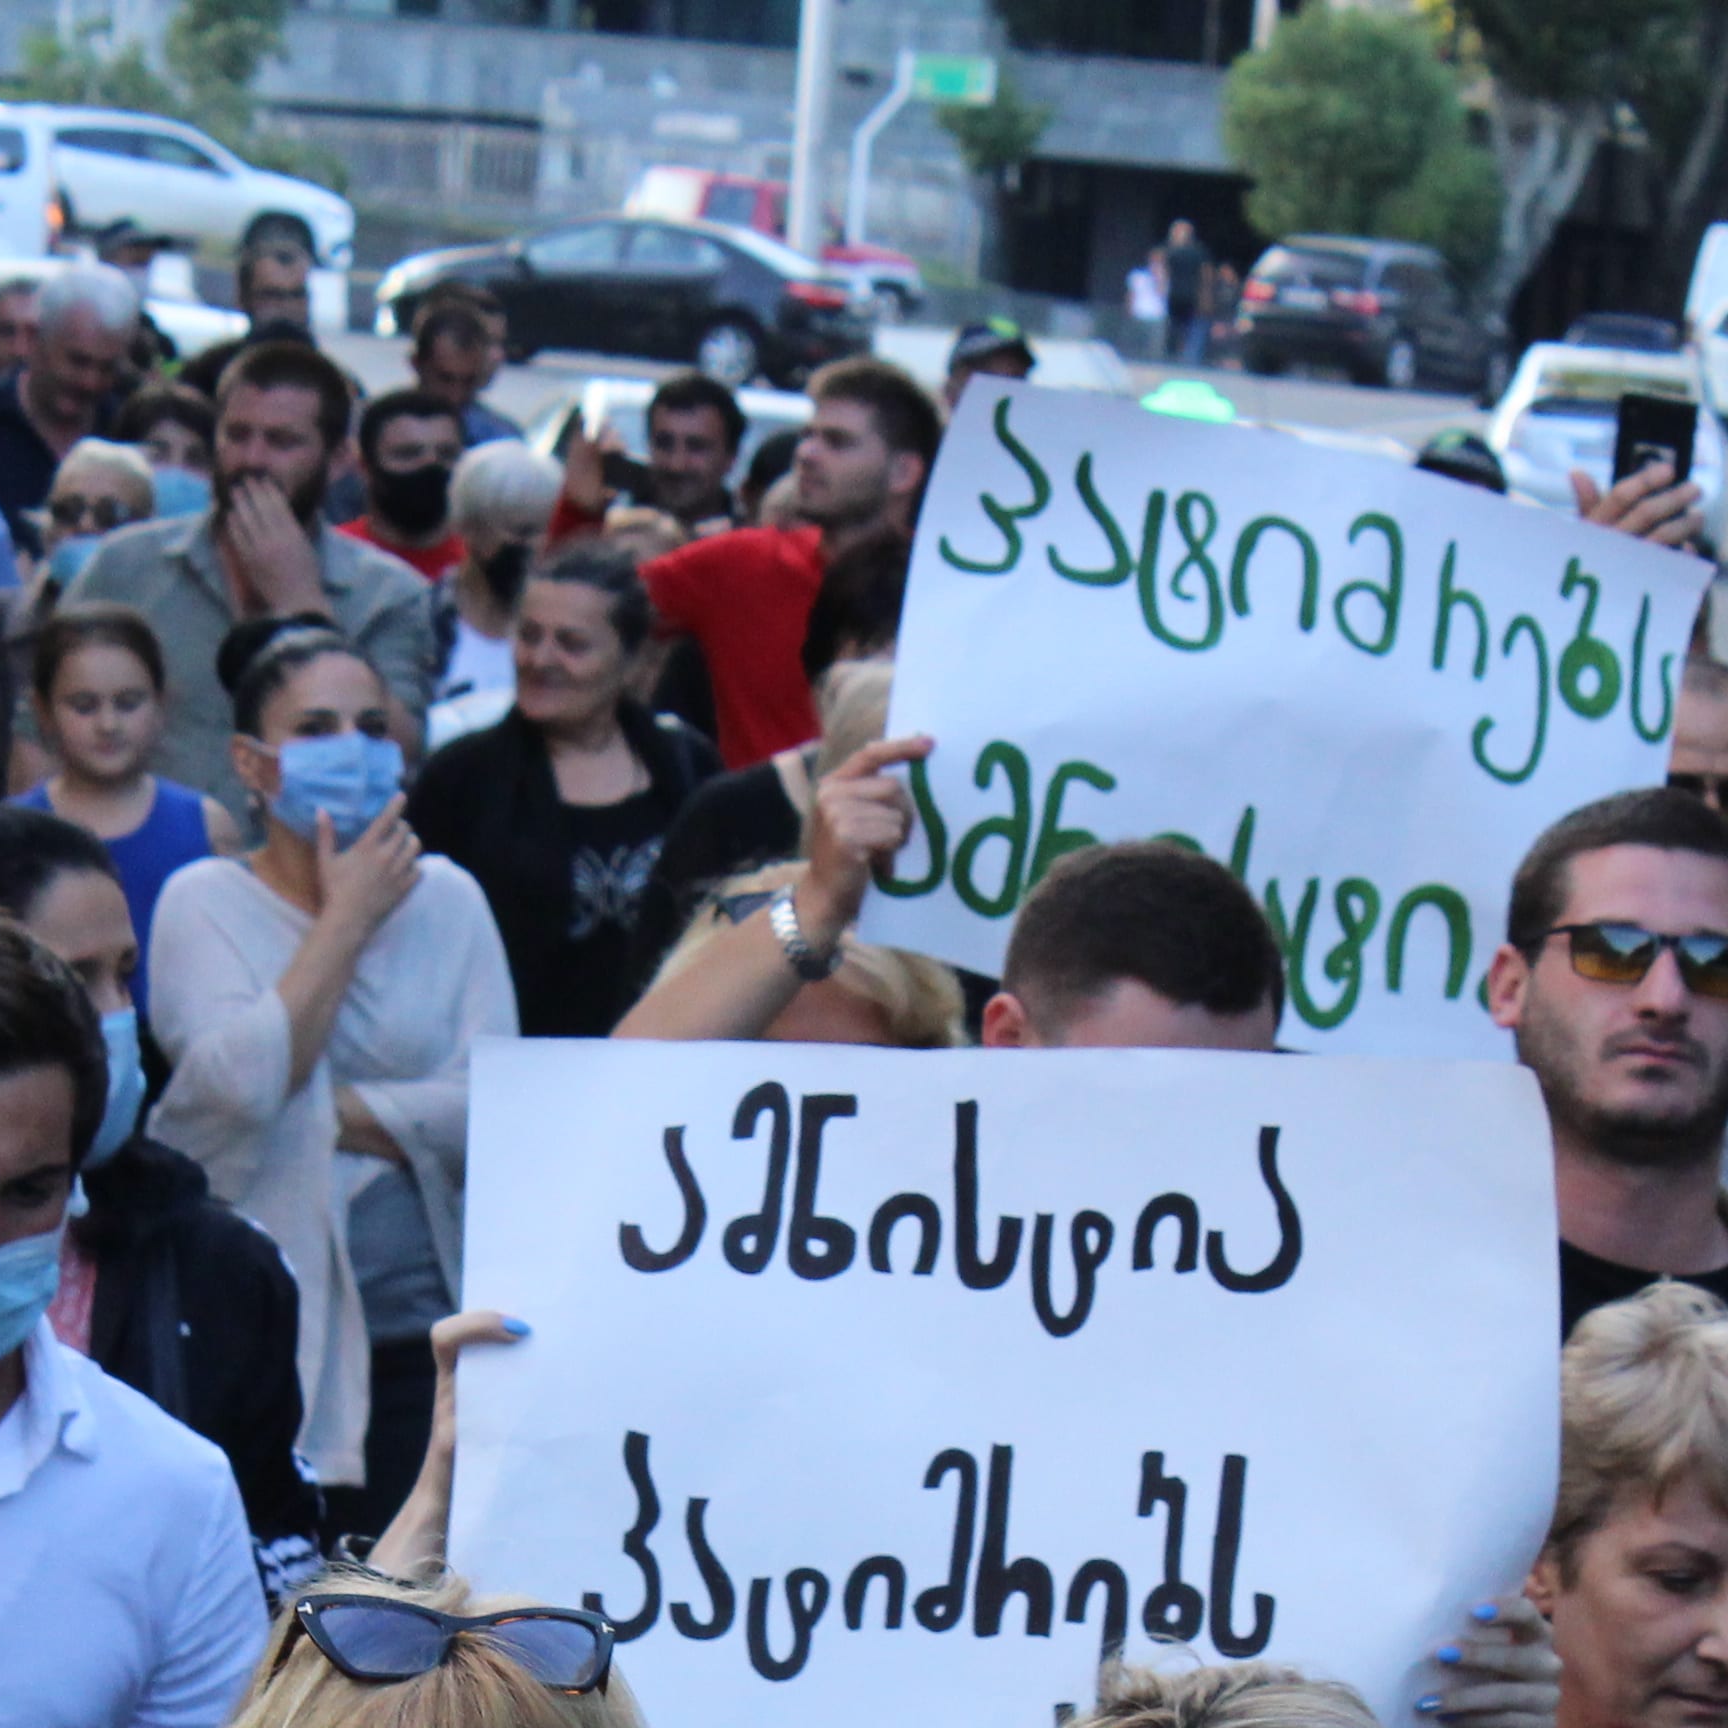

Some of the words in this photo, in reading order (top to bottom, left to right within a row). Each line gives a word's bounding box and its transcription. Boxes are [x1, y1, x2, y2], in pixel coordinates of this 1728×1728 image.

[940, 396, 1675, 785] პატიმრებს
[619, 1081, 1303, 1338] ამნისტია
[580, 1430, 1276, 1728] პატიმრებს
